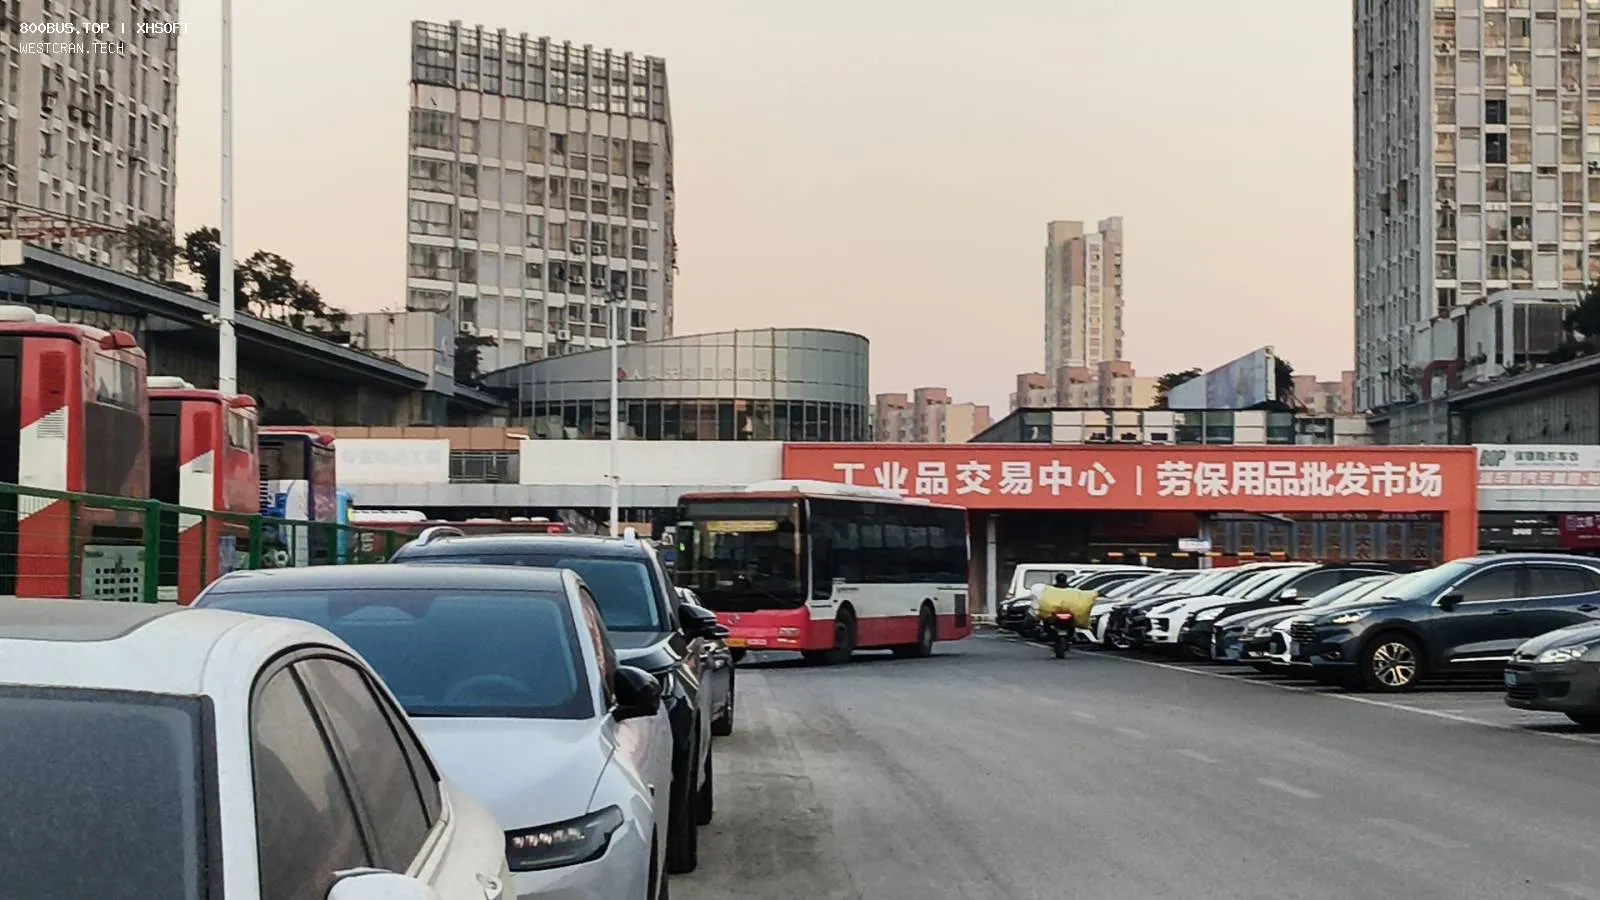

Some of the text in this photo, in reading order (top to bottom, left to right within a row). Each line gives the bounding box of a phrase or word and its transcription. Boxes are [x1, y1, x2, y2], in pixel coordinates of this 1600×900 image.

[833, 460, 1117, 496] 工业品交易中心
[1156, 460, 1442, 497] 劳保用品批发市场
